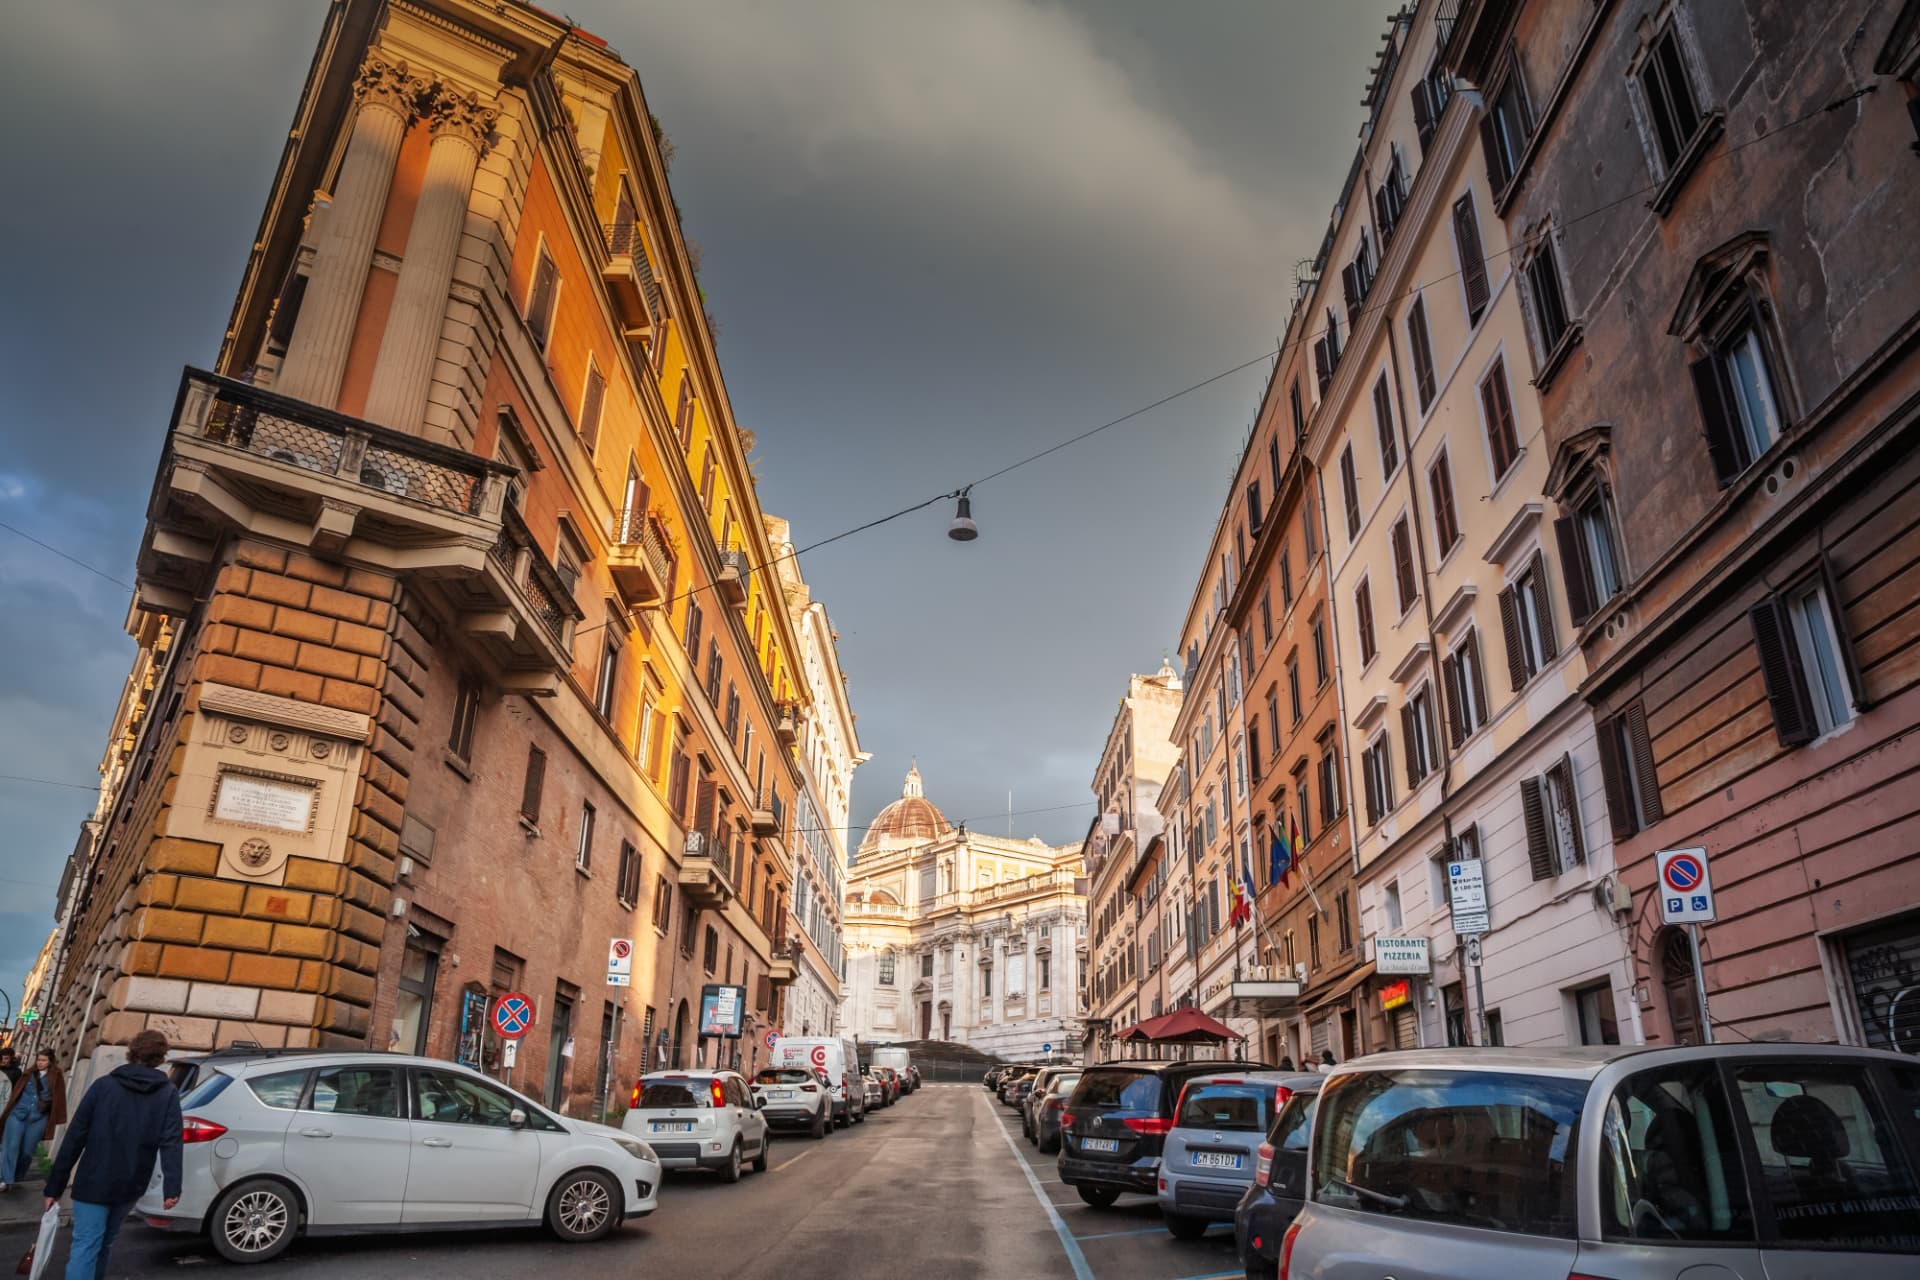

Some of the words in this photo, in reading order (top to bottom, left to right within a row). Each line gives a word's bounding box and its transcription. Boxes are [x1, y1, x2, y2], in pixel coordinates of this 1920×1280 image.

[1452, 866, 1459, 875] P
[1670, 900, 1680, 911] P
[1377, 939, 1426, 948] RISTORANTE
[1383, 952, 1421, 961] PIZZERIA
